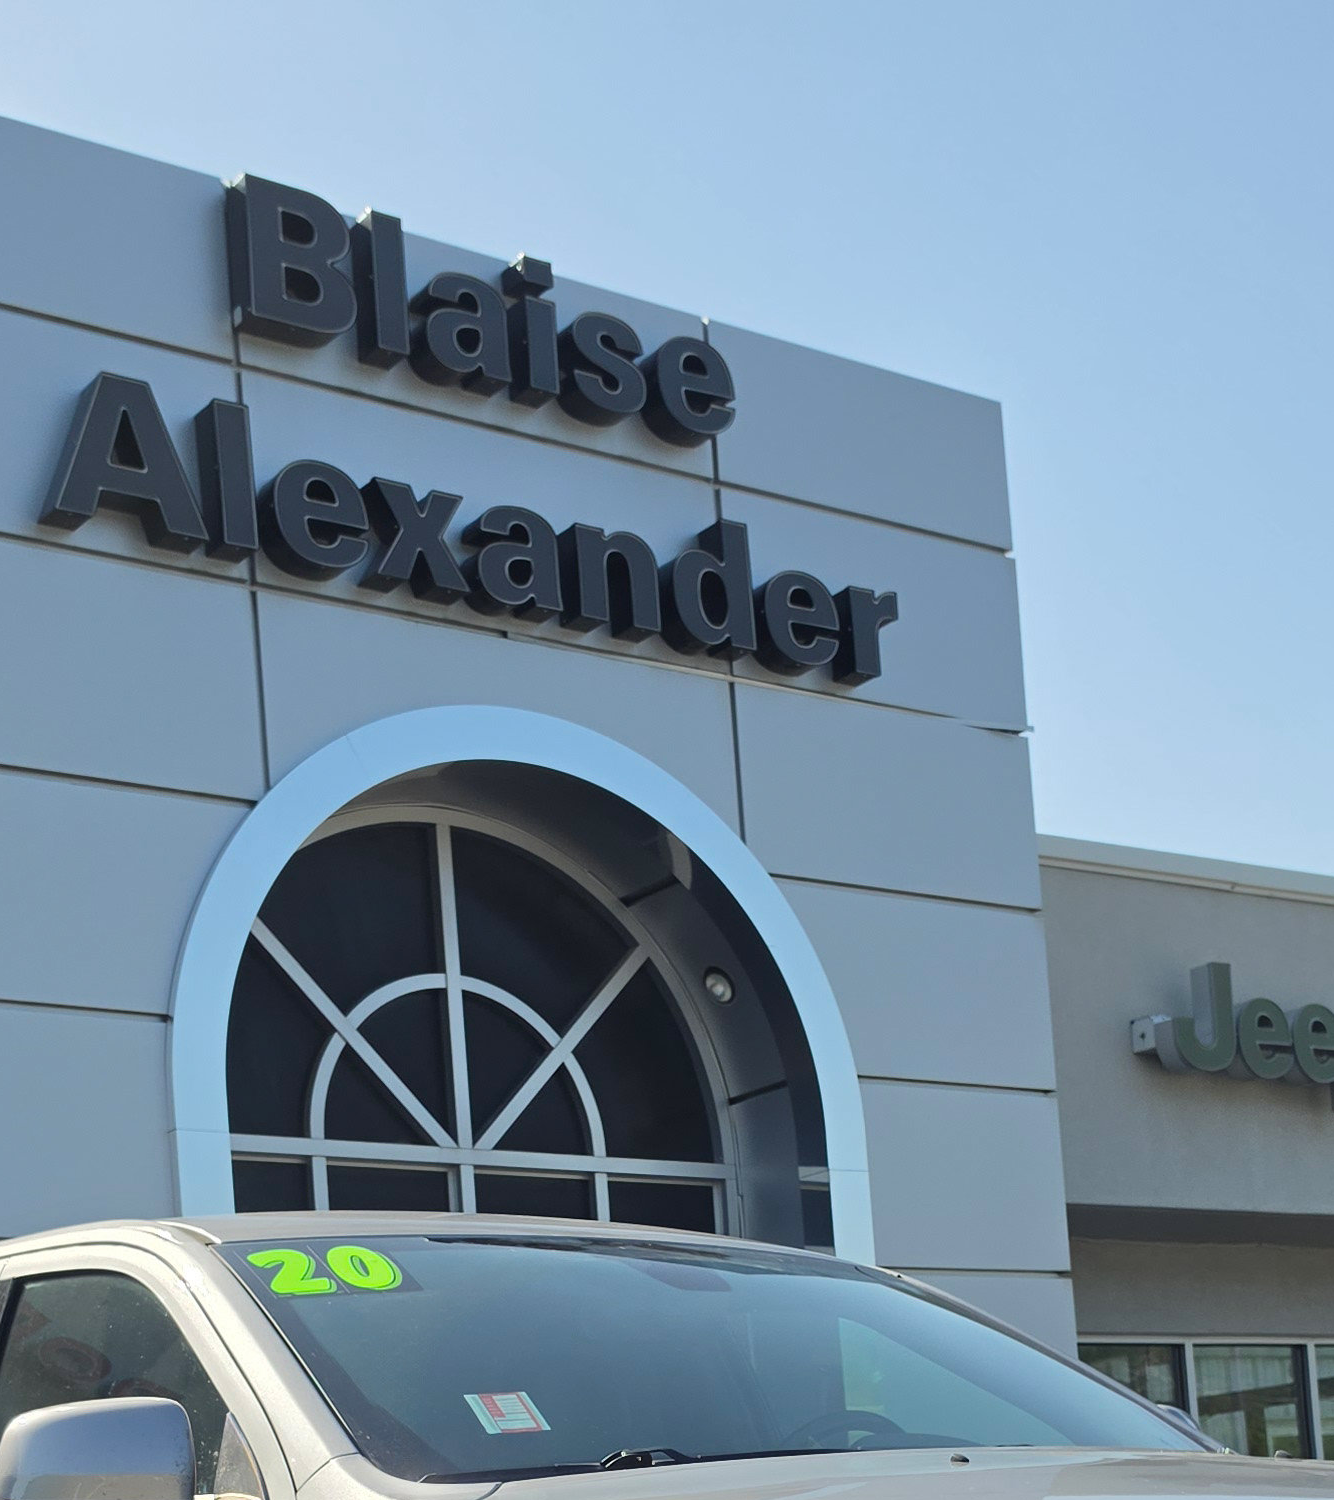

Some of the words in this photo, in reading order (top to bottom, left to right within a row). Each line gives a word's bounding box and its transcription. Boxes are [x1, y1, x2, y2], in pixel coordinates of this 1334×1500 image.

[227, 173, 737, 448] Blaise
[39, 371, 899, 686] Alexander
[246, 1245, 403, 1296] 20
